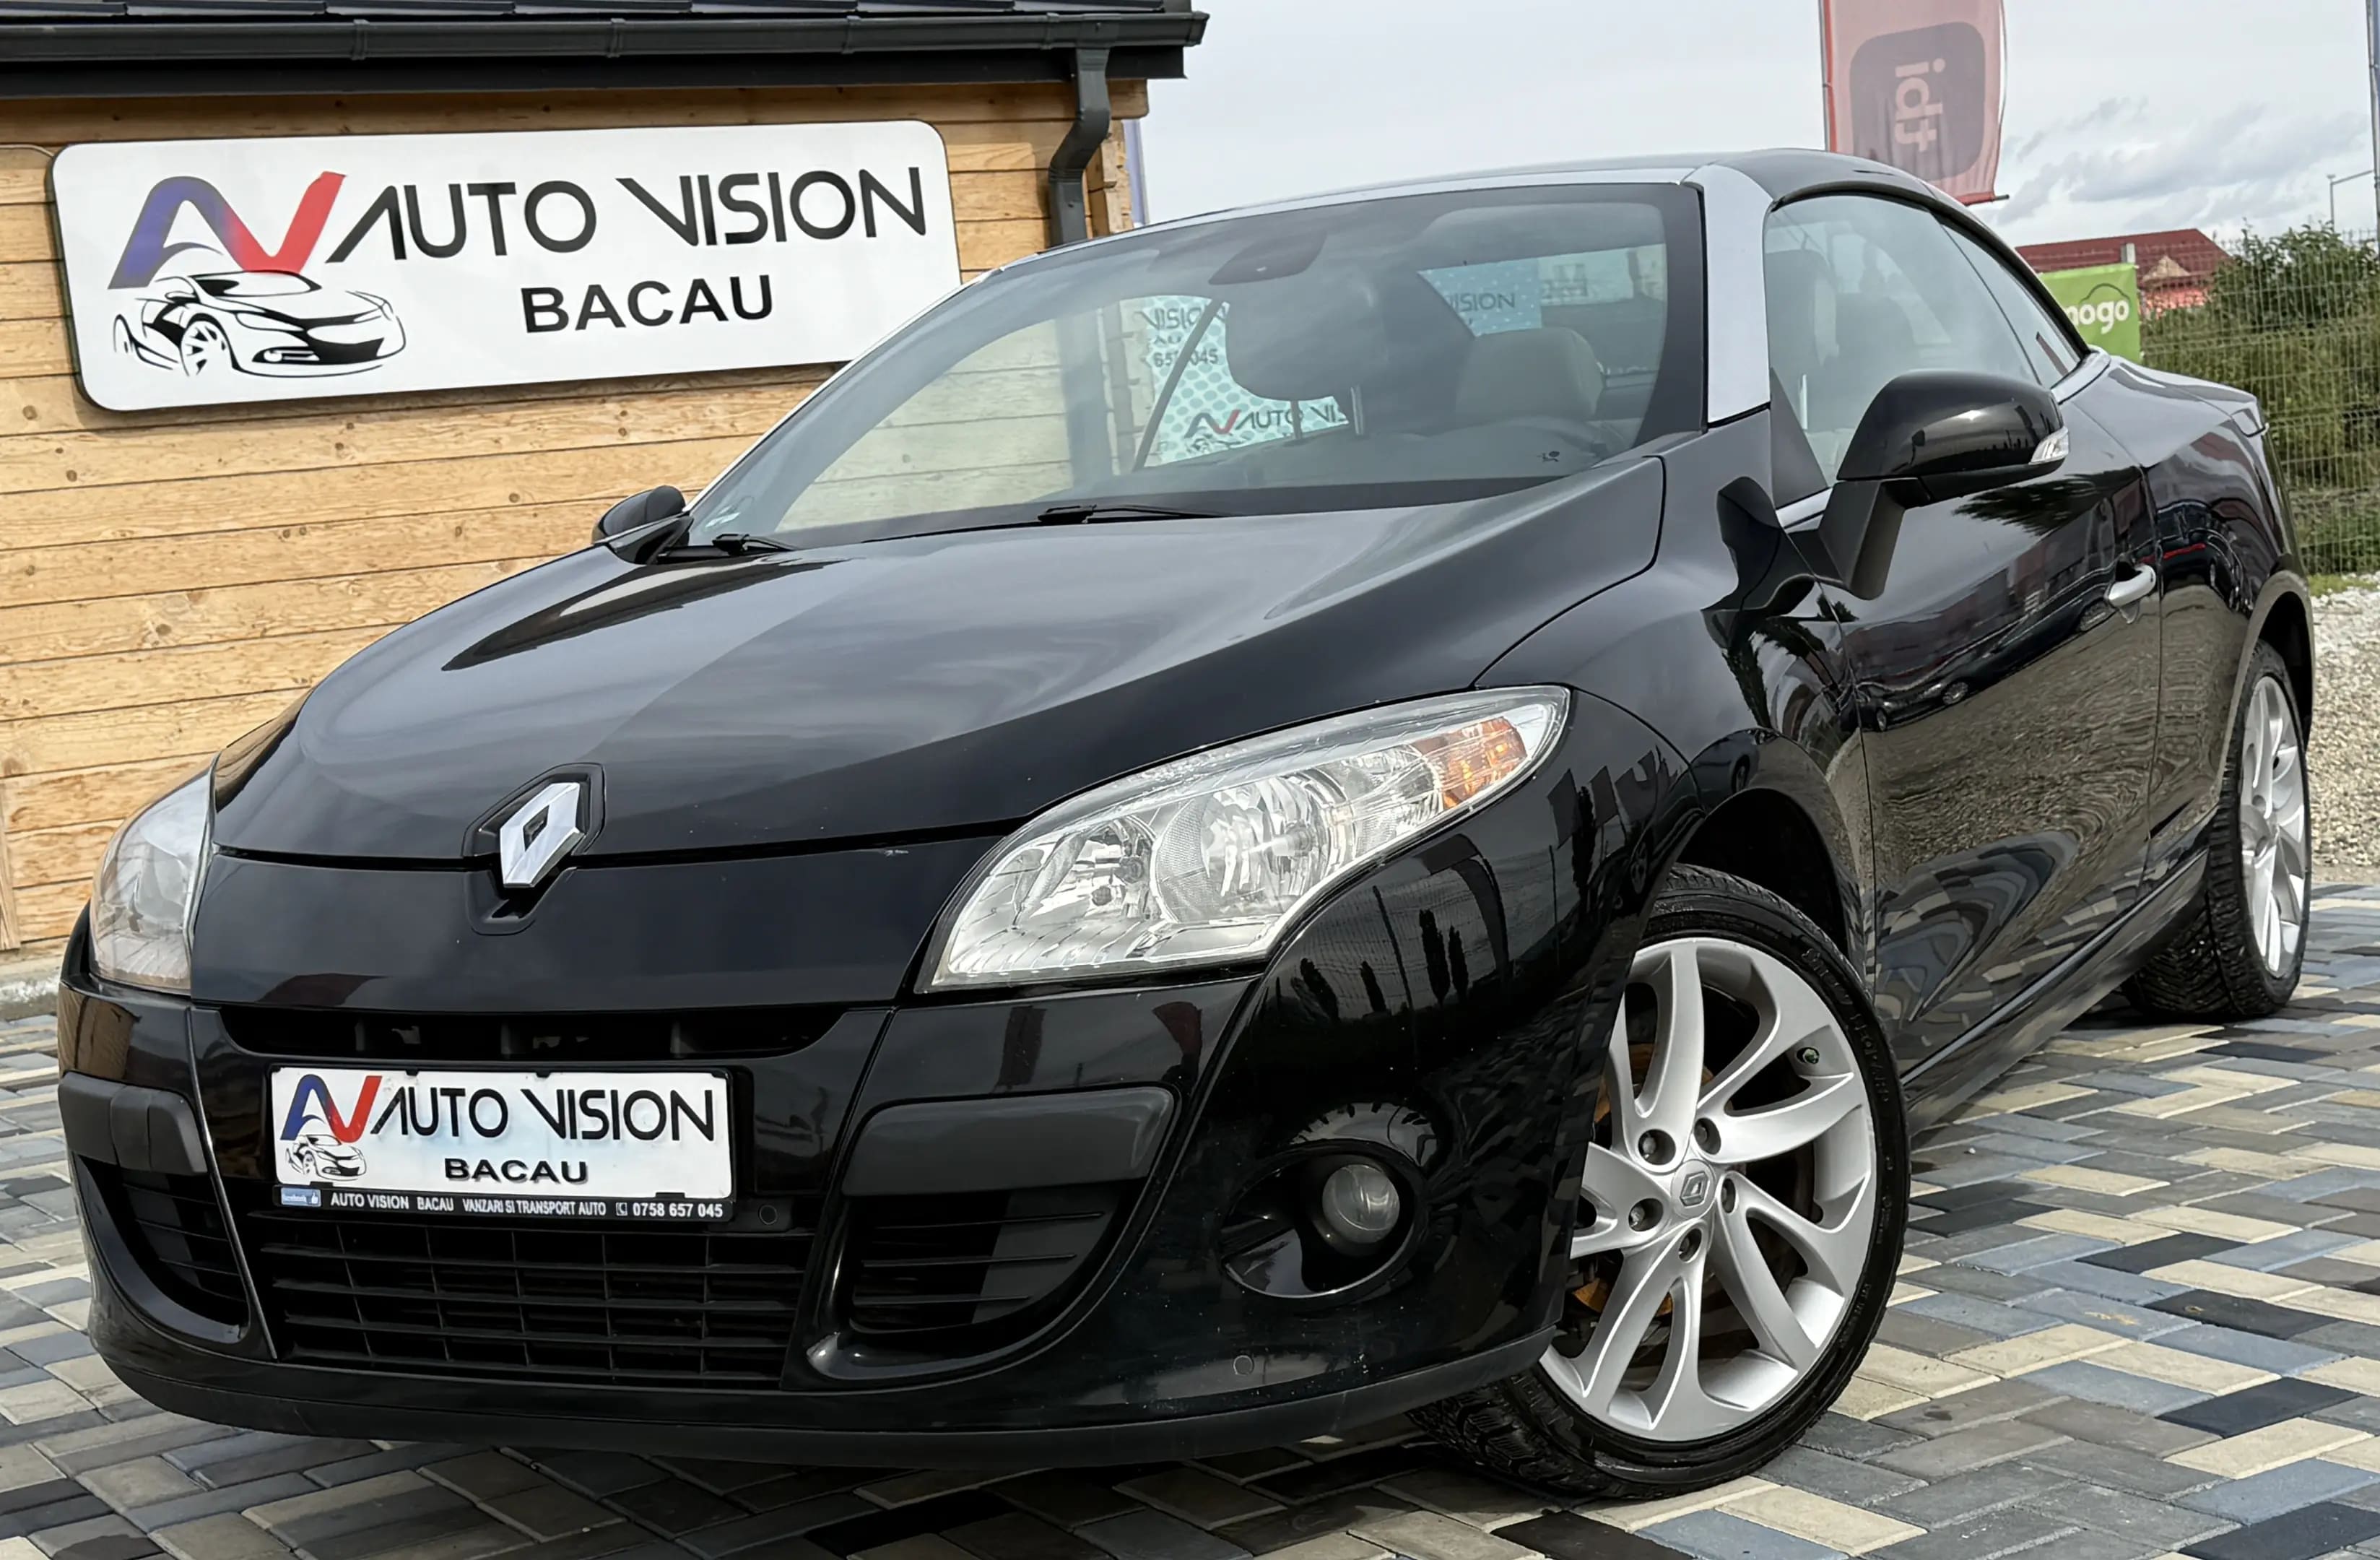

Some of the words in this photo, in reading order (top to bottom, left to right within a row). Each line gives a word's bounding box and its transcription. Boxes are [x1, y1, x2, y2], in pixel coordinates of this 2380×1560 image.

[326, 181, 597, 264] AUTO
[616, 167, 926, 247] VISION
[521, 274, 773, 334] BACAU
[370, 1087, 509, 1138] AUTO
[520, 1088, 715, 1142] VISION
[444, 1158, 589, 1184] BACAU
[330, 1192, 364, 1208] AUTO
[368, 1194, 409, 1210] VISION
[417, 1196, 454, 1211] BACAU
[462, 1198, 503, 1213] VANZARI
[505, 1200, 516, 1213] SI
[516, 1200, 576, 1216] TRANSPORT
[578, 1201, 607, 1216] AUTO
[633, 1202, 665, 1217] 0758
[669, 1202, 693, 1218] 657
[698, 1204, 723, 1218] 045
